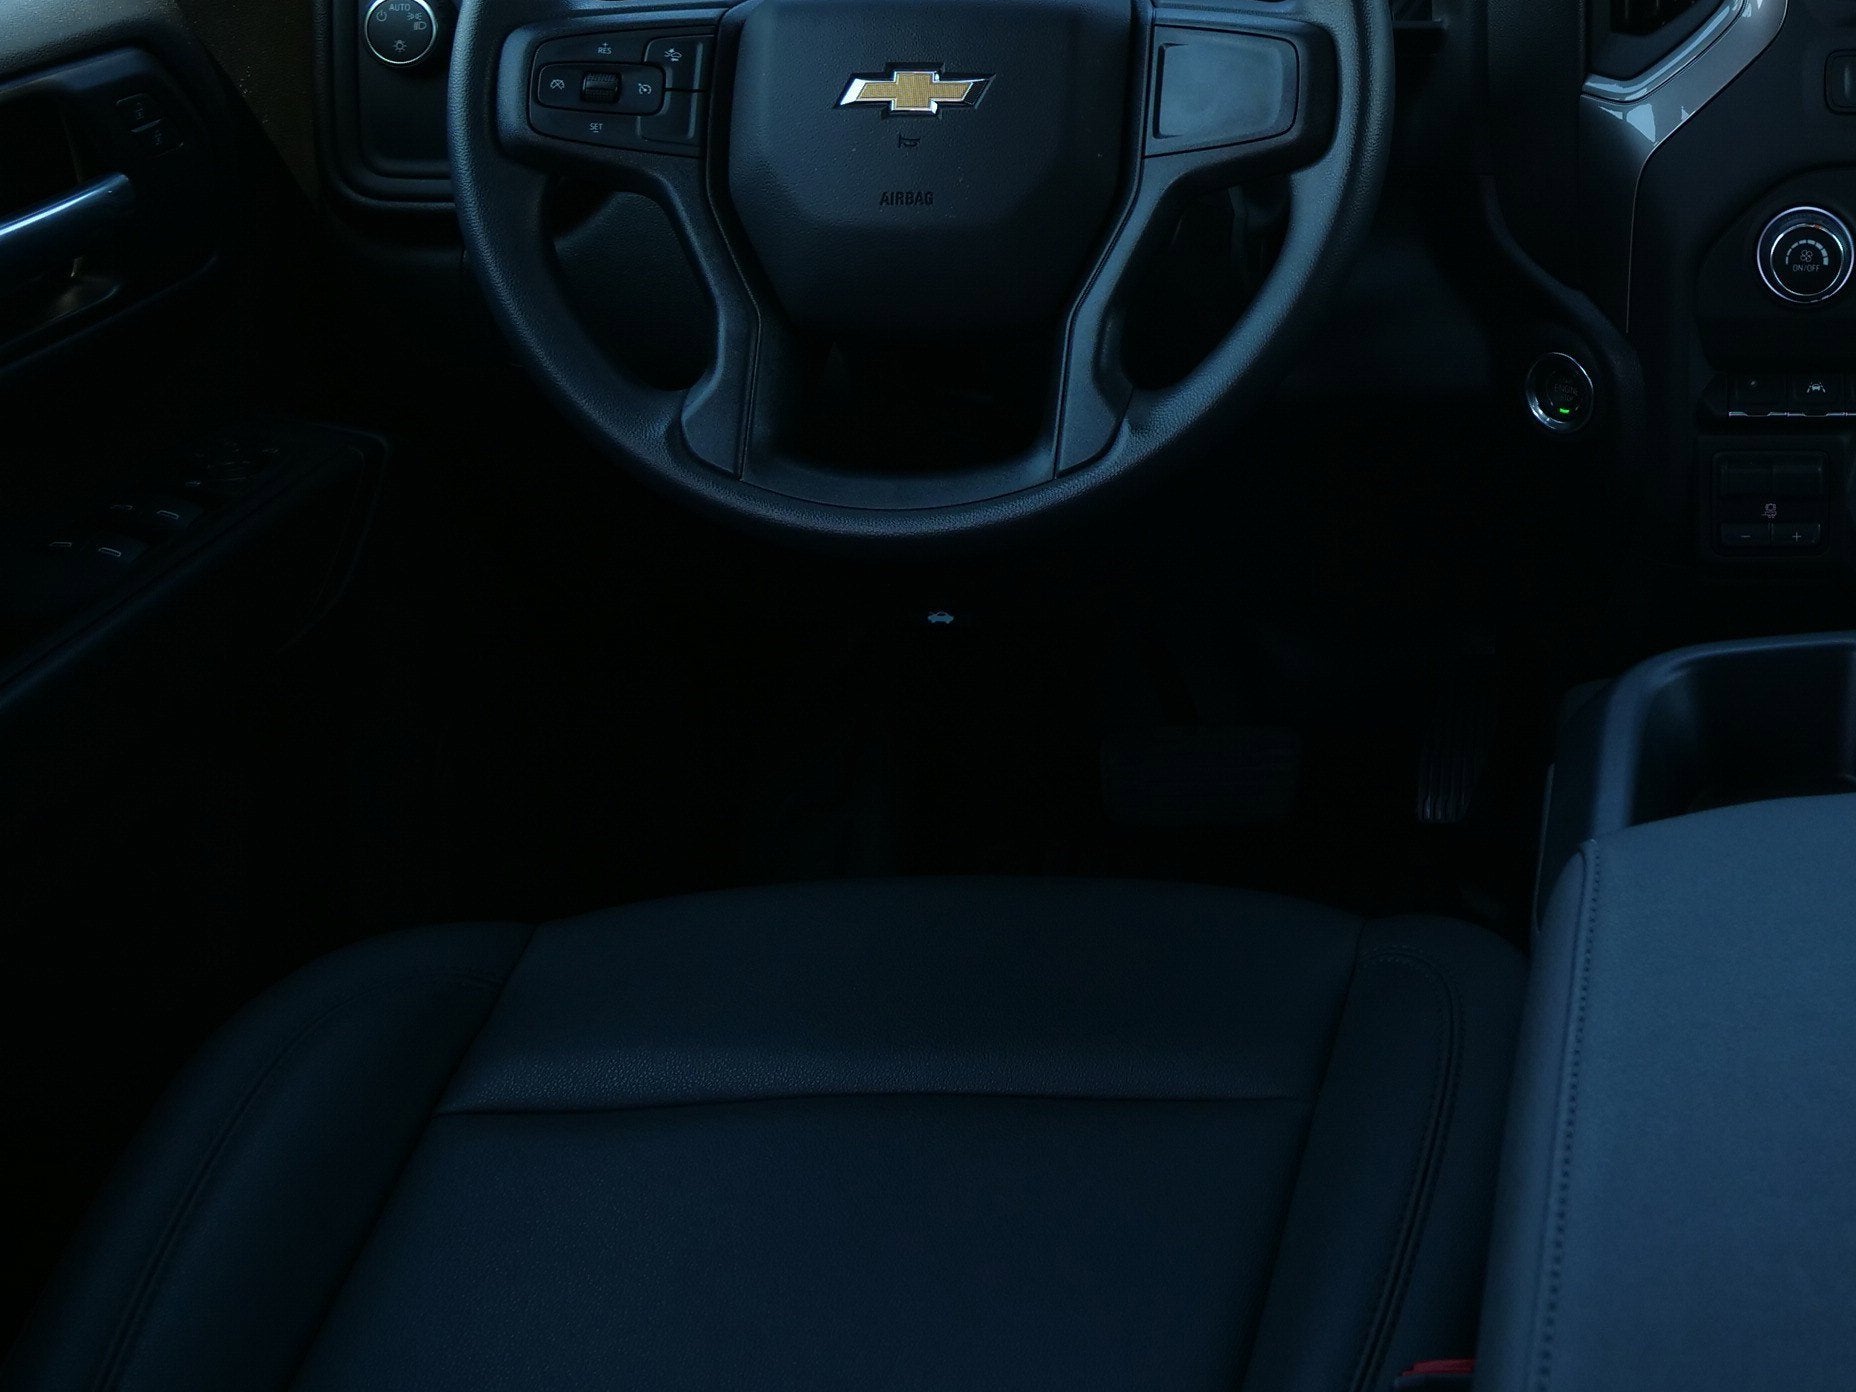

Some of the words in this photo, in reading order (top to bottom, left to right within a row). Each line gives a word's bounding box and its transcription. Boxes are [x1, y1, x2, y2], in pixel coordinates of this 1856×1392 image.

[390, 3, 411, 11] AUTO
[597, 47, 612, 55] RES
[880, 191, 934, 206] AIRBAG
[1792, 264, 1820, 273] ON/OFF
